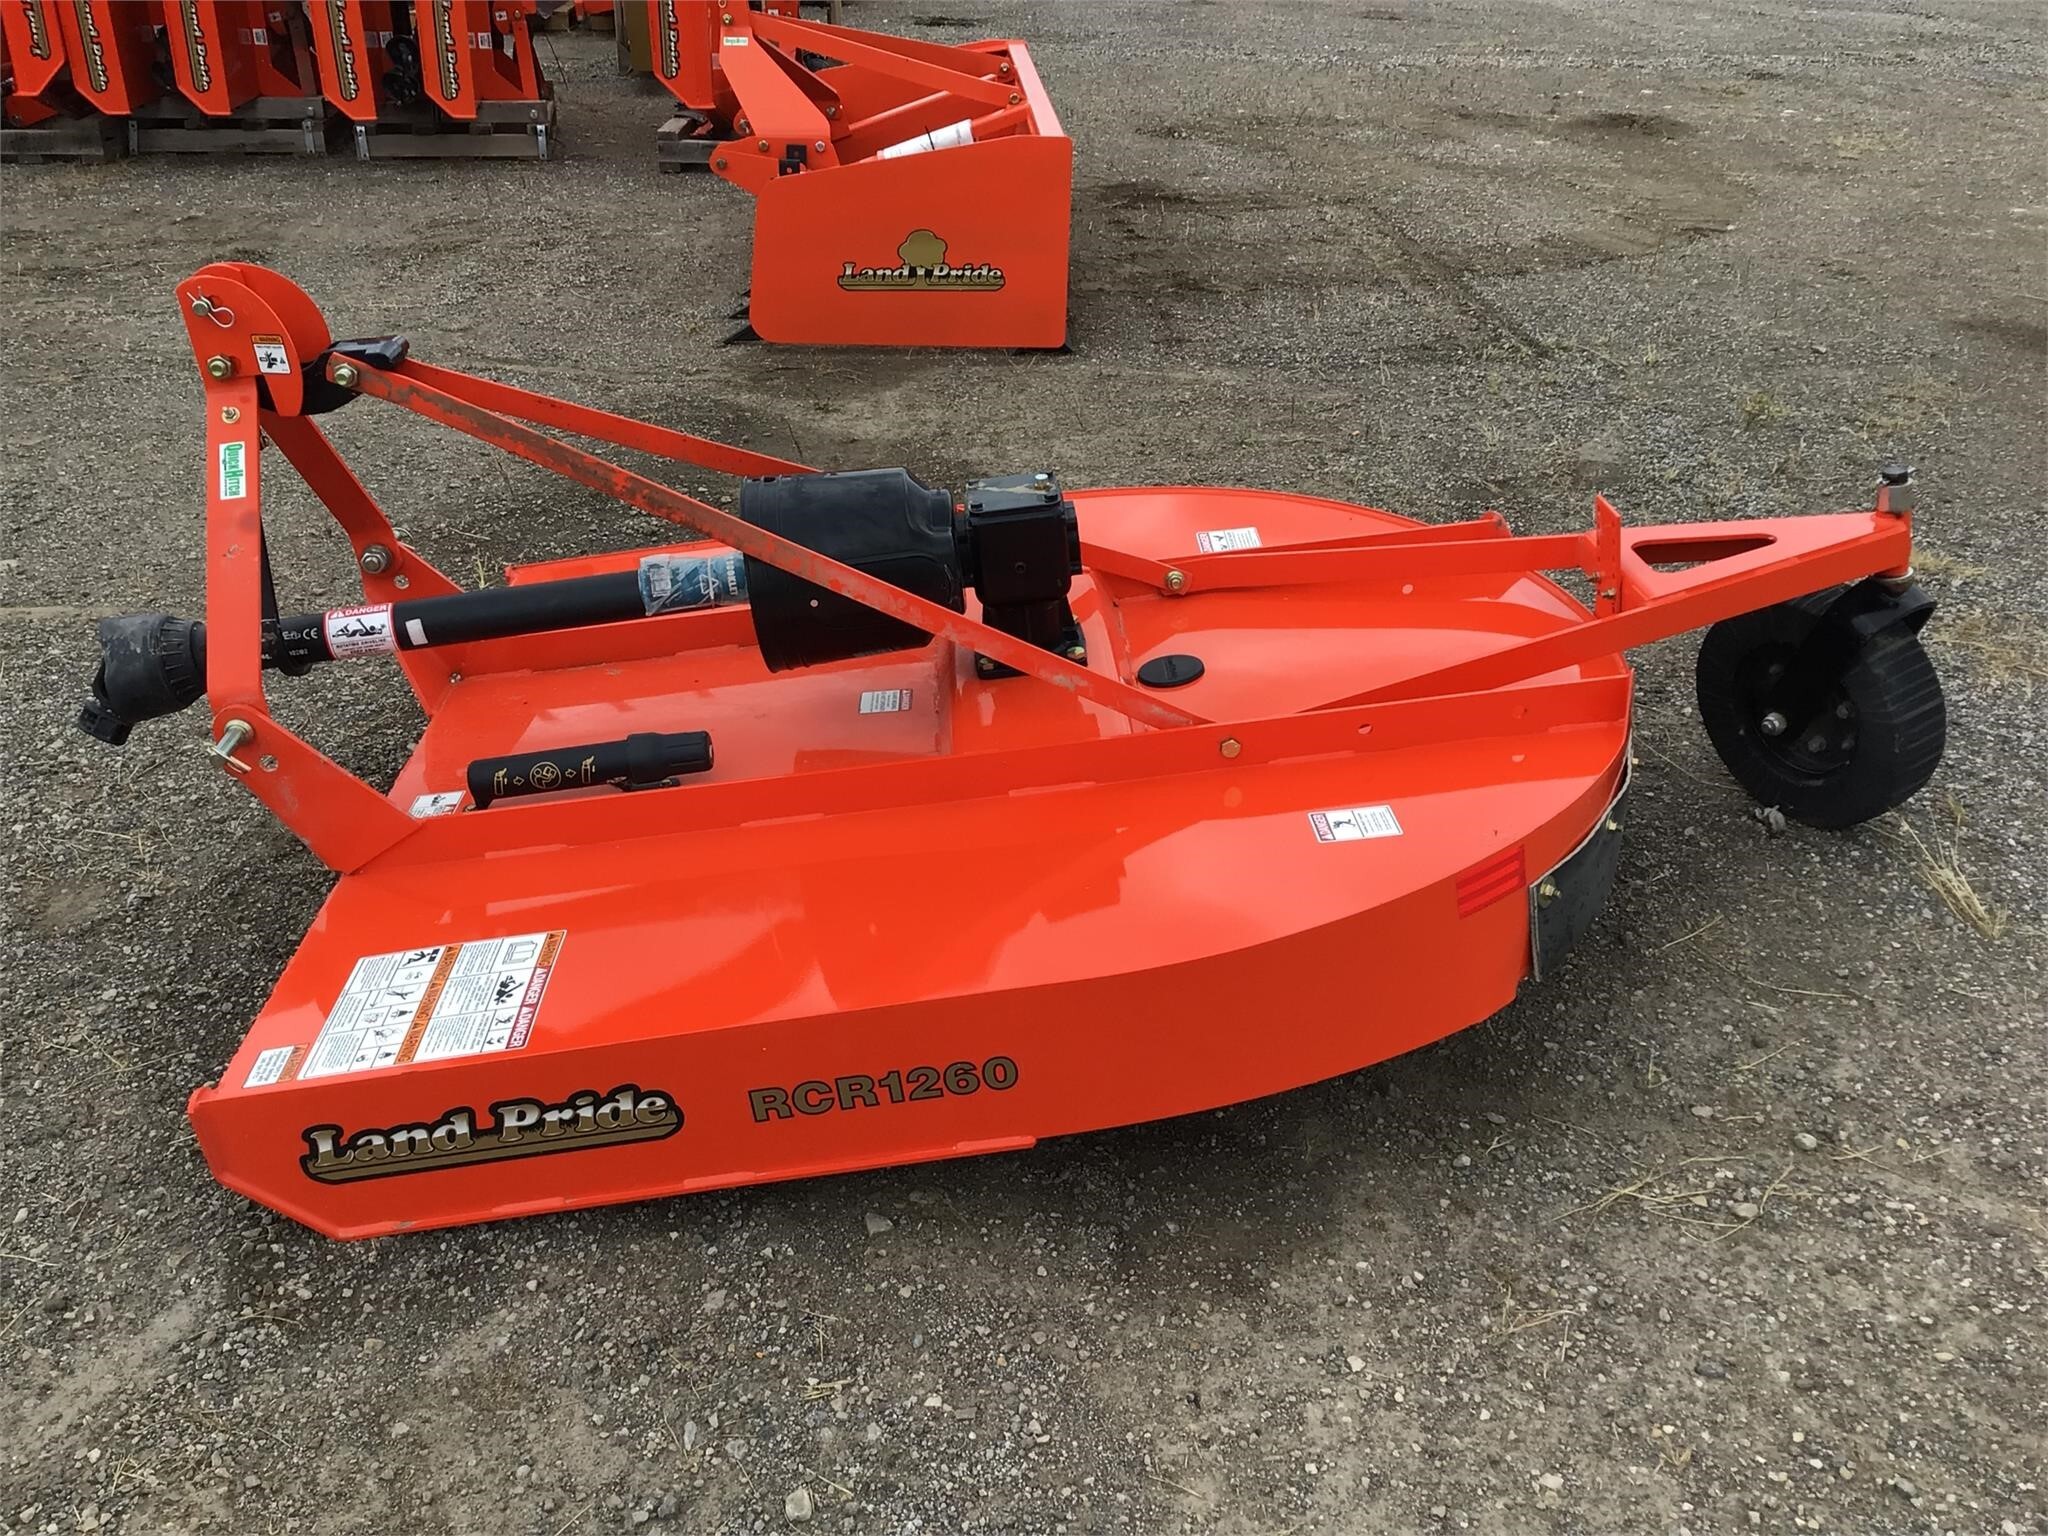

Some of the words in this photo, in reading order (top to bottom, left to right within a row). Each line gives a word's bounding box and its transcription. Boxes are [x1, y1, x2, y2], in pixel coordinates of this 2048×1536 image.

[842, 262, 911, 283] Land
[929, 263, 1002, 283] Pride
[345, 604, 387, 616] DANGER
[523, 972, 546, 1005] DANGER
[507, 1011, 532, 1048] DANGER
[748, 1056, 1019, 1123] RCR1260
[310, 1111, 475, 1168] Land
[497, 1089, 667, 1142] Pride
